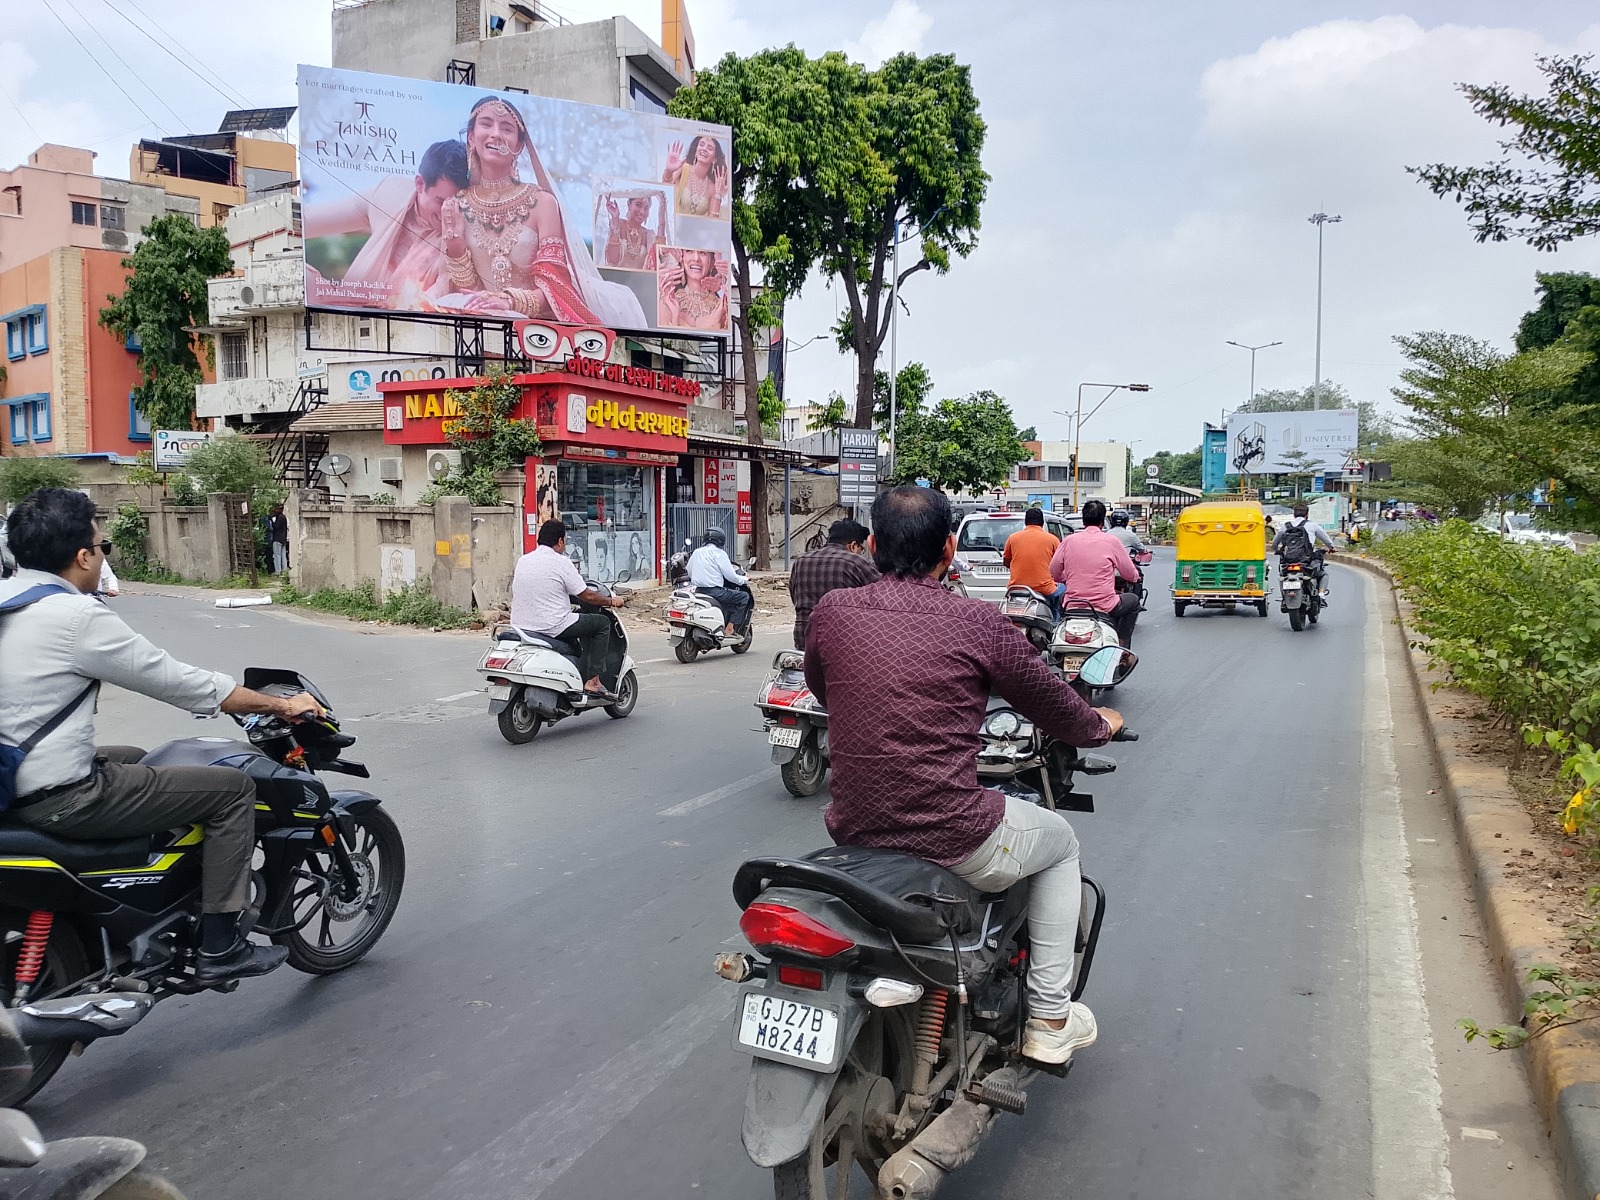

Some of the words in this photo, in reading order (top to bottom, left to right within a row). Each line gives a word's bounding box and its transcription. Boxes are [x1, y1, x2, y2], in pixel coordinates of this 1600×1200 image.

[305, 79, 319, 88] For
[322, 83, 364, 94] marriages
[365, 87, 395, 98] crafted
[396, 90, 405, 99] by
[408, 93, 423, 101] you
[318, 158, 362, 172] Wedding
[364, 164, 416, 176] Signatures
[332, 278, 340, 288] by
[340, 279, 362, 289] Joseph
[316, 288, 325, 297] Jai
[325, 288, 346, 298] Mahal
[368, 292, 388, 302] Jaipur
[842, 432, 877, 447] HARDIK
[1305, 434, 1352, 443] UNIVERSE
[761, 997, 824, 1032] GJ27B
[755, 1022, 818, 1059] M8244
